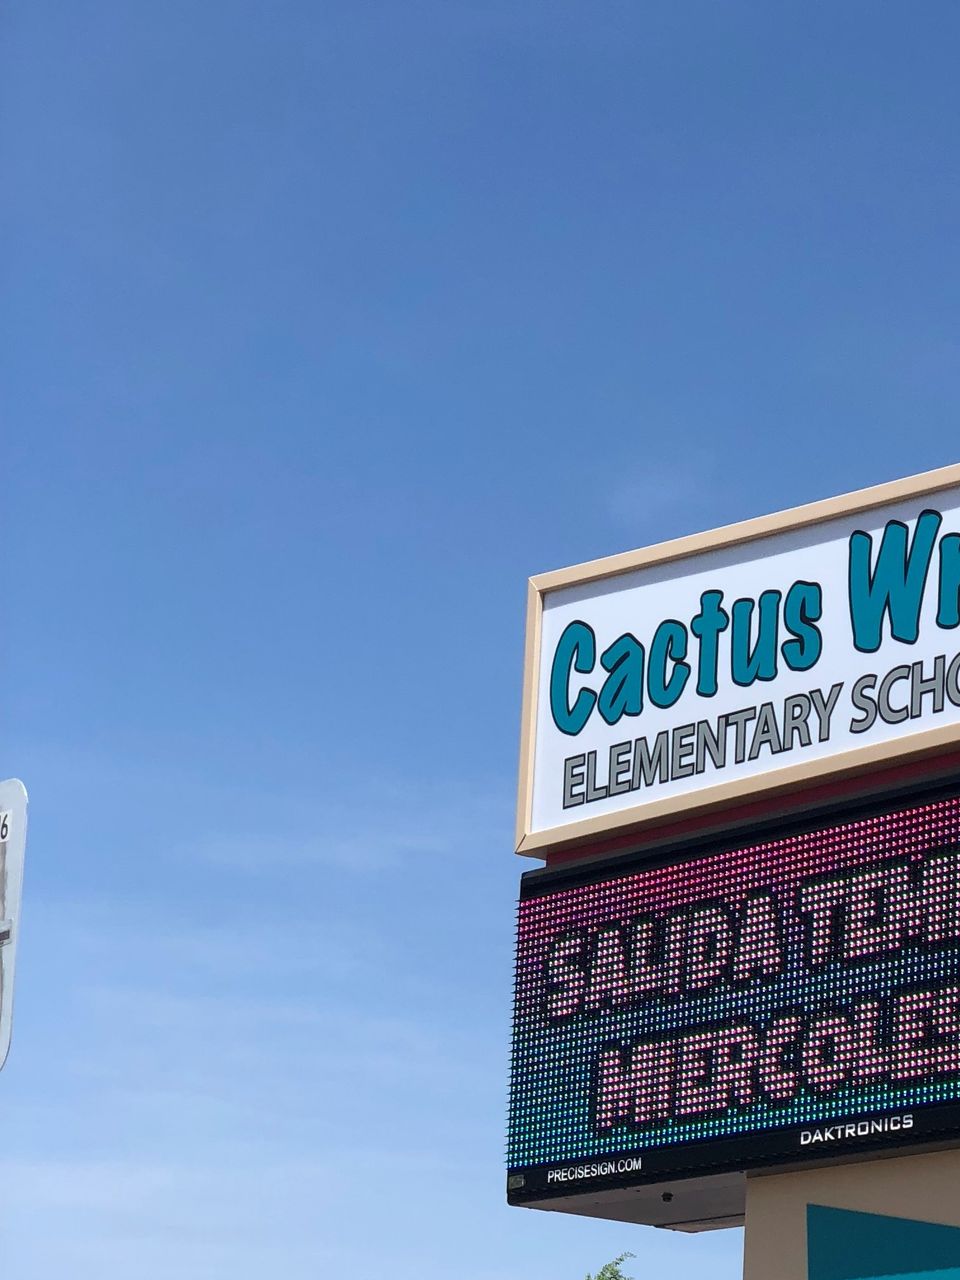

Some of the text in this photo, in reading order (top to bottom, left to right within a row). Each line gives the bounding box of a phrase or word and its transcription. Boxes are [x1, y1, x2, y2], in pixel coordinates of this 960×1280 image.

[550, 580, 822, 736] Cactus
[562, 682, 844, 810] ELEMENTARY
[546, 894, 783, 1019] SALIDA
[547, 1157, 642, 1184] PRECISESIGN.COM
[800, 1114, 914, 1146] DAKTRONICS
